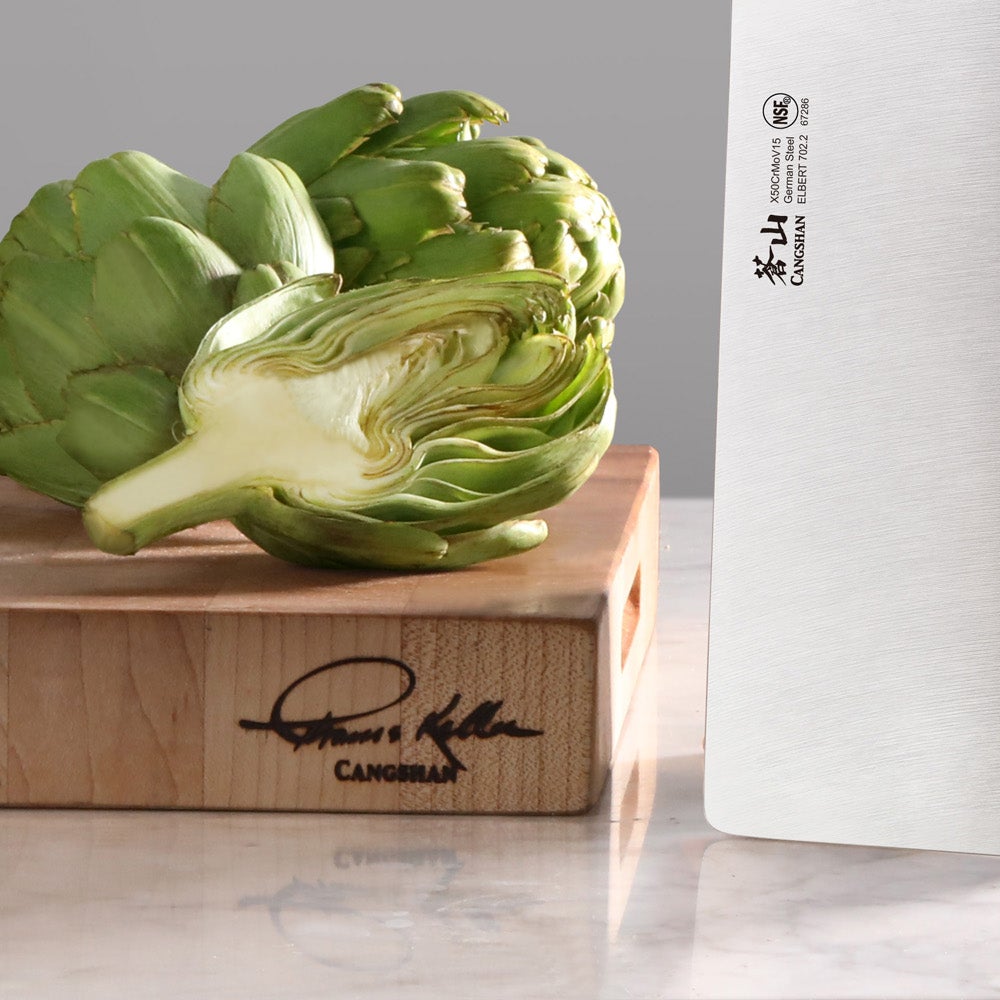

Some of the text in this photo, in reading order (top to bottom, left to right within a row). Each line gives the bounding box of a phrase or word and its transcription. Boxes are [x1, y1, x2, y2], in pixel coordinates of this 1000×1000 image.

[801, 97, 810, 125] 67286
[770, 137, 782, 203] X50CrMoV15
[784, 136, 795, 203] German Steel
[797, 134, 809, 203] ELBERT 702.2
